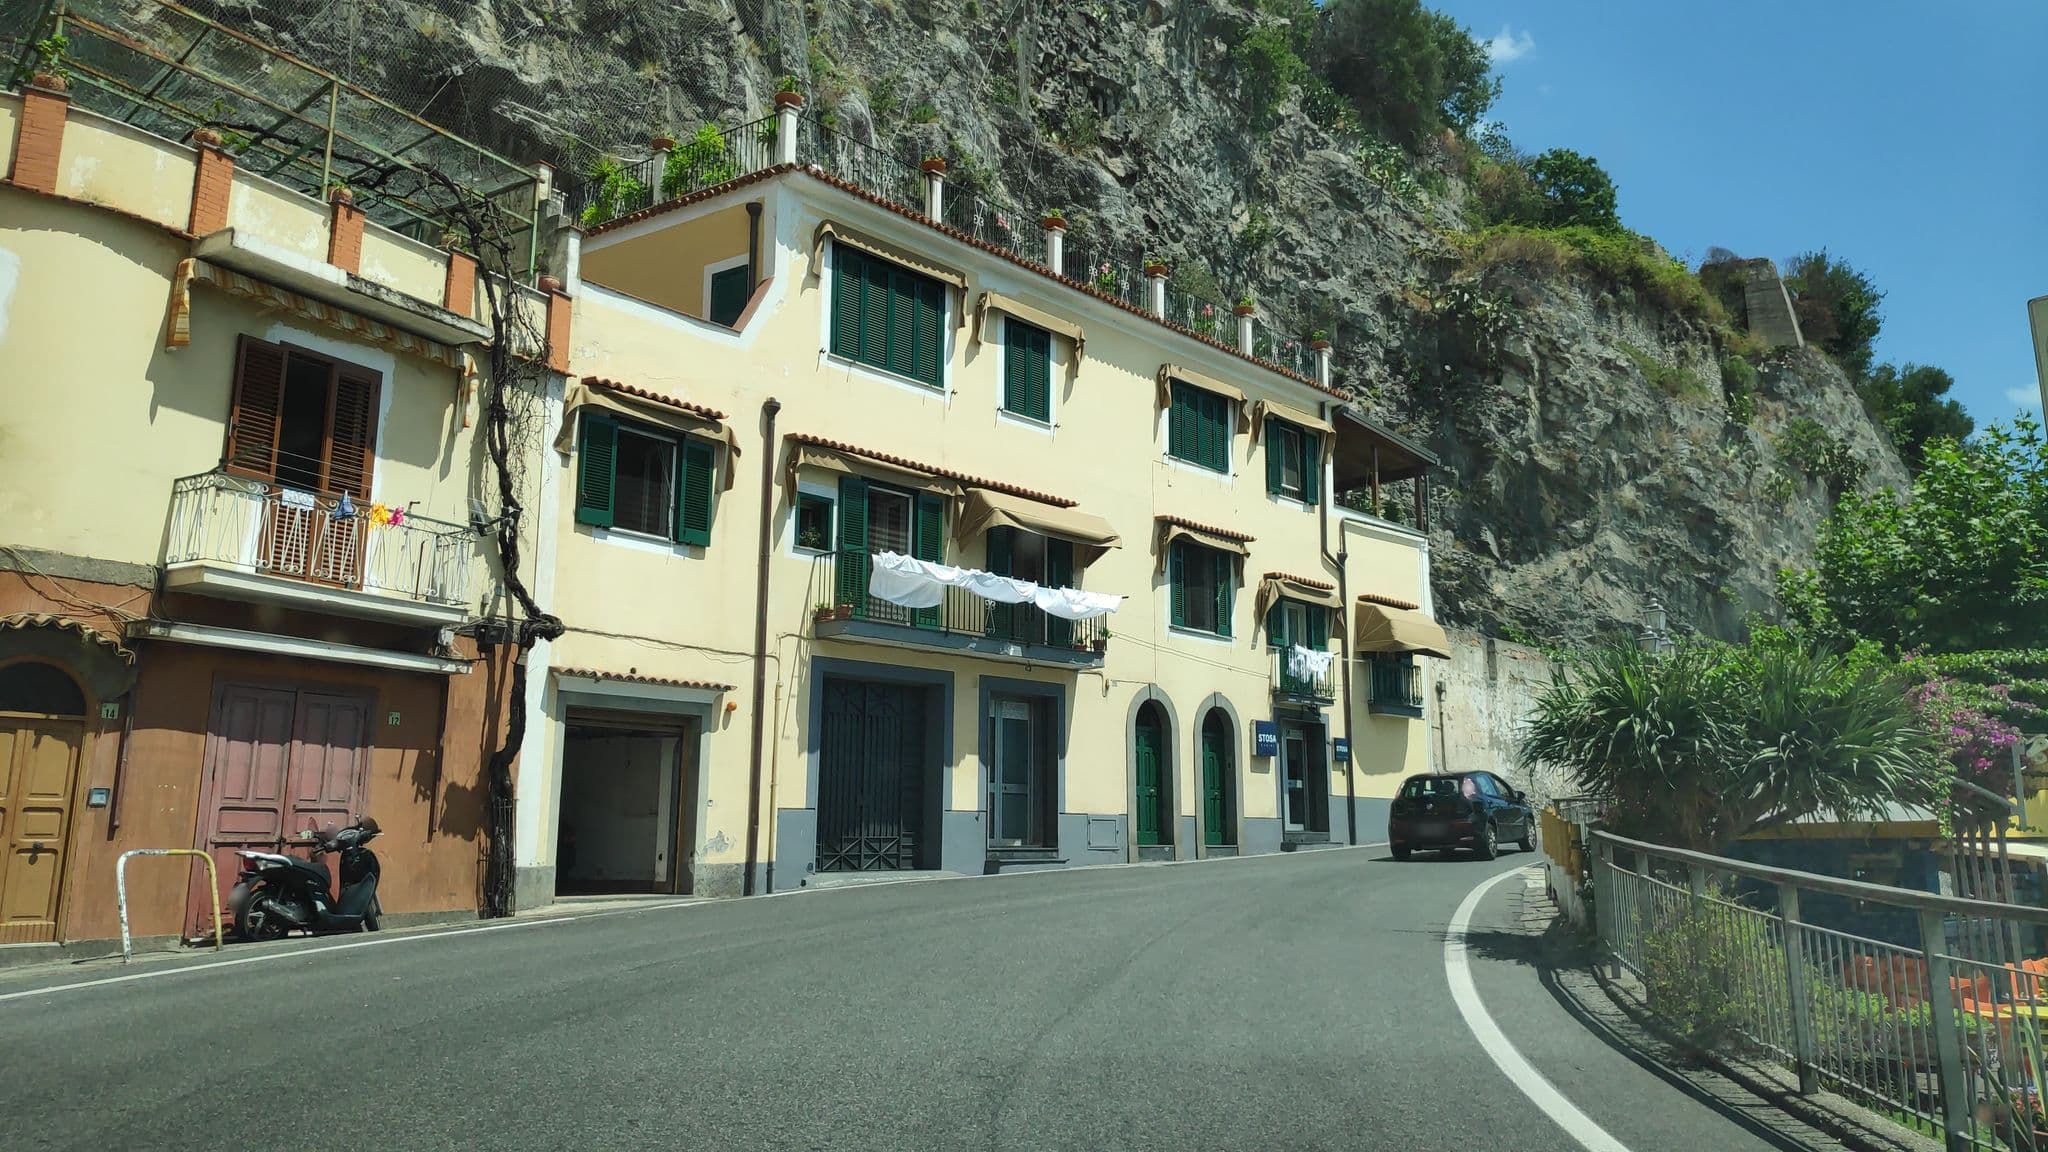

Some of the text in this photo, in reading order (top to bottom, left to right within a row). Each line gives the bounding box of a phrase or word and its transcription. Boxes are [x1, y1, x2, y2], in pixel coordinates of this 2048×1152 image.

[105, 708, 115, 718] 14
[391, 716, 399, 726] 12
[1258, 733, 1277, 743] STOSA
